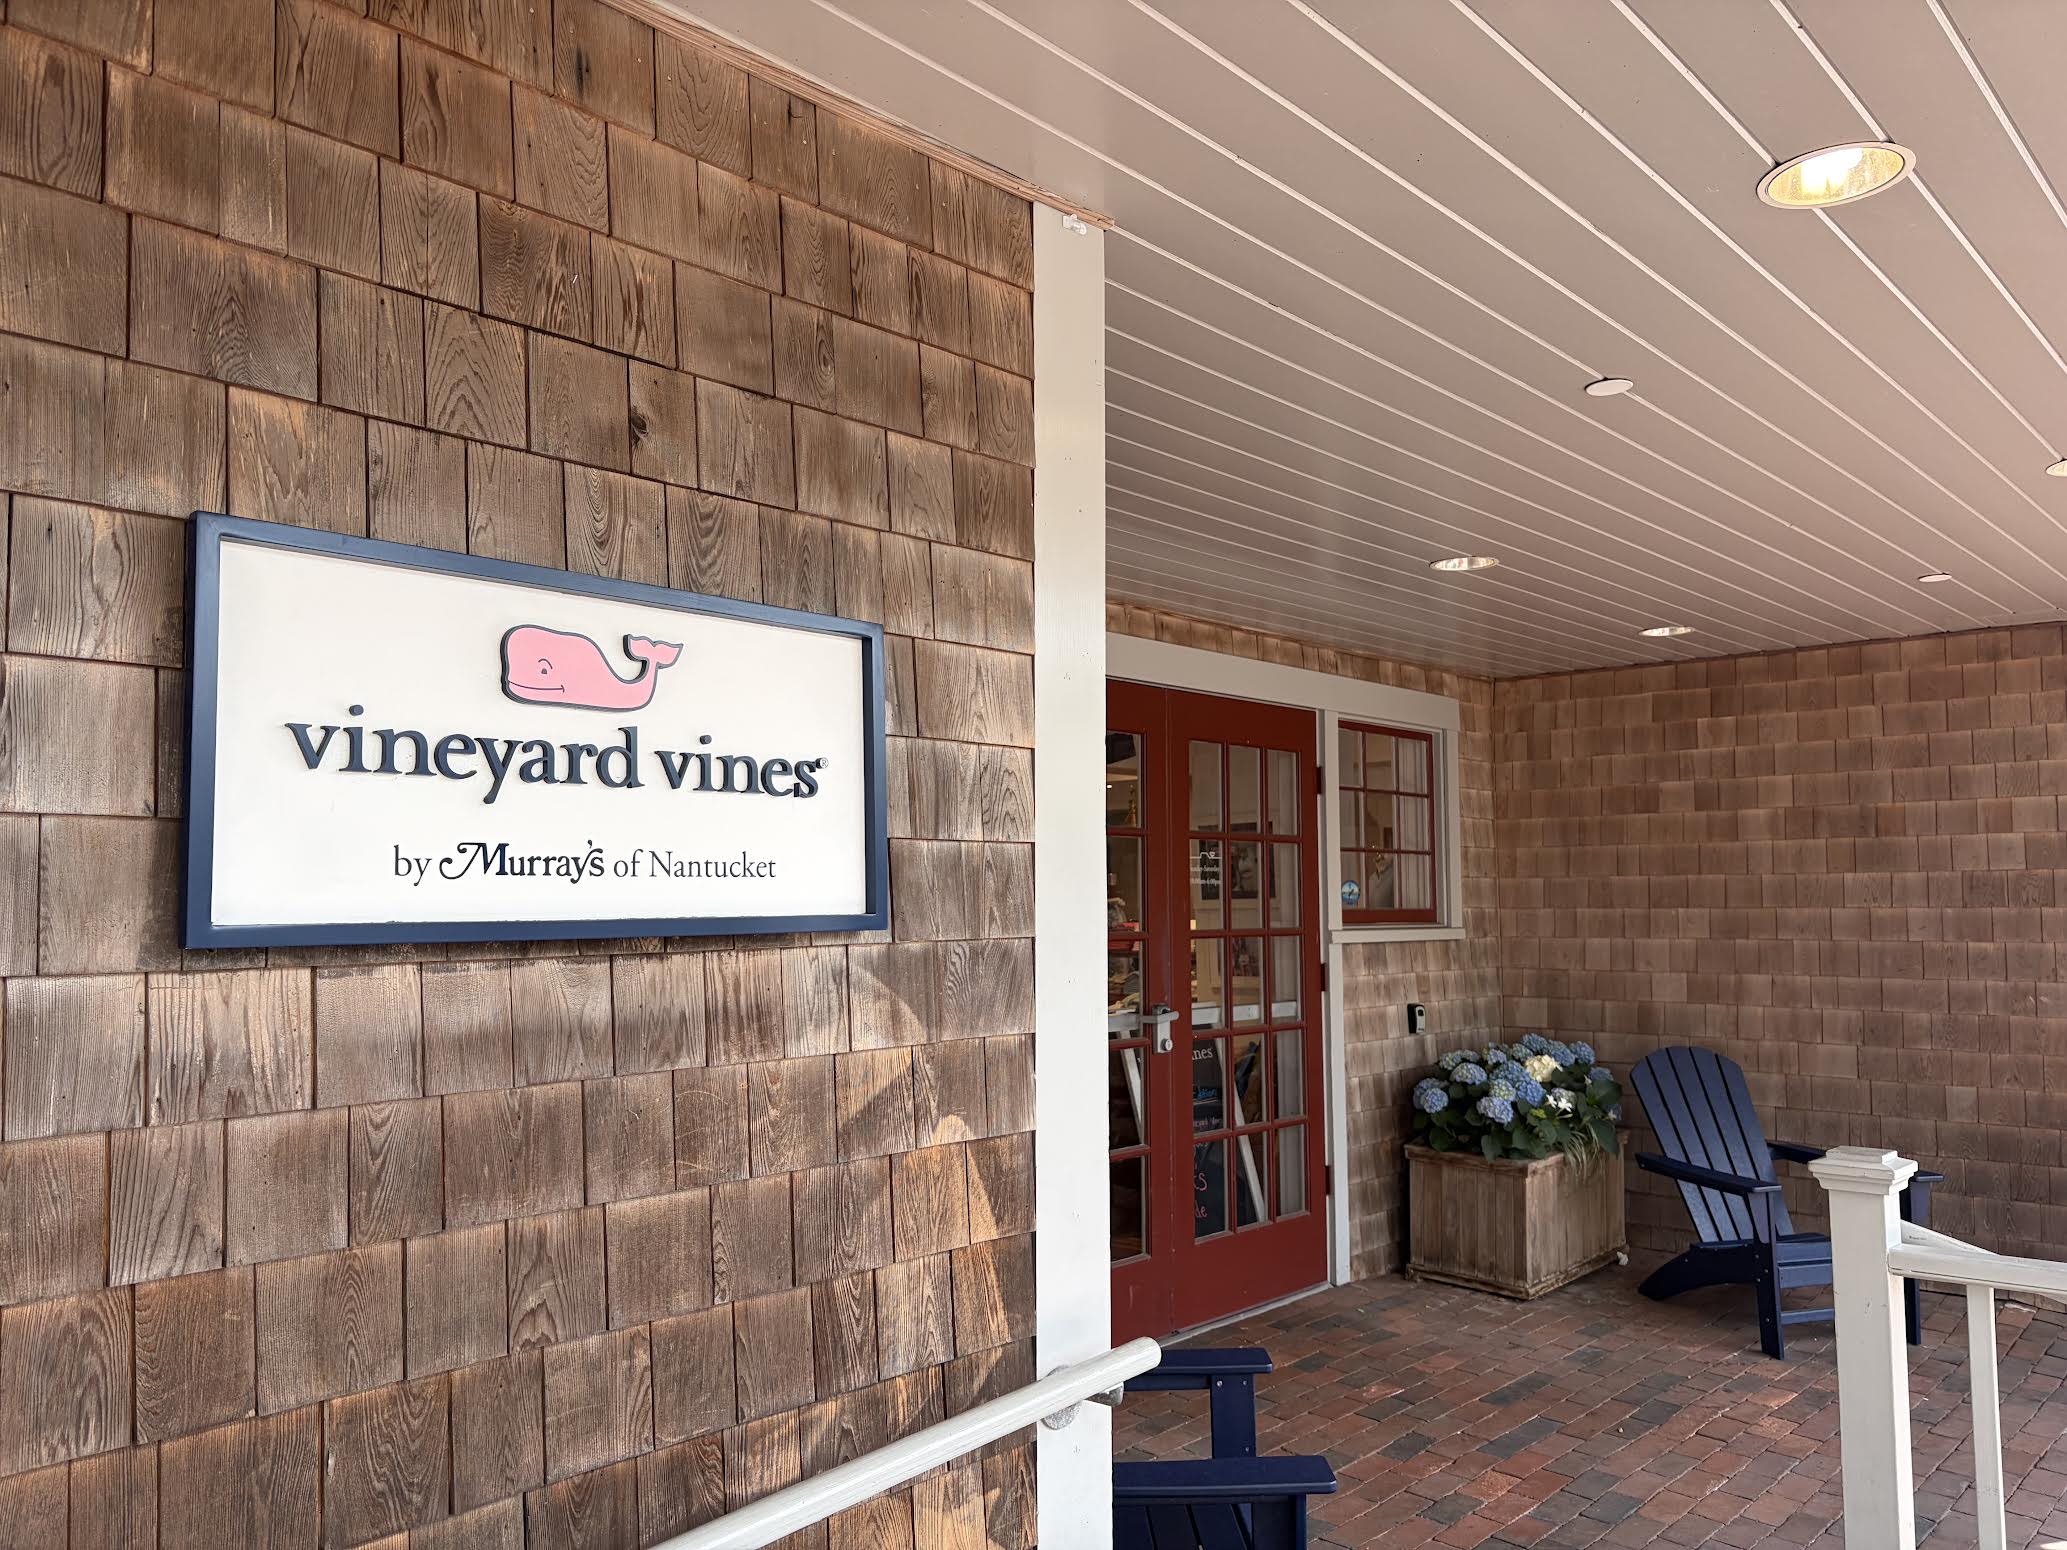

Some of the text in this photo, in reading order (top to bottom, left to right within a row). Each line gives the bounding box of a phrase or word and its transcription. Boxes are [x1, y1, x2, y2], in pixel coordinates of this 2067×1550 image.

[284, 704, 645, 804] vineyard
[394, 840, 776, 886] by Murray's of Nantucket
